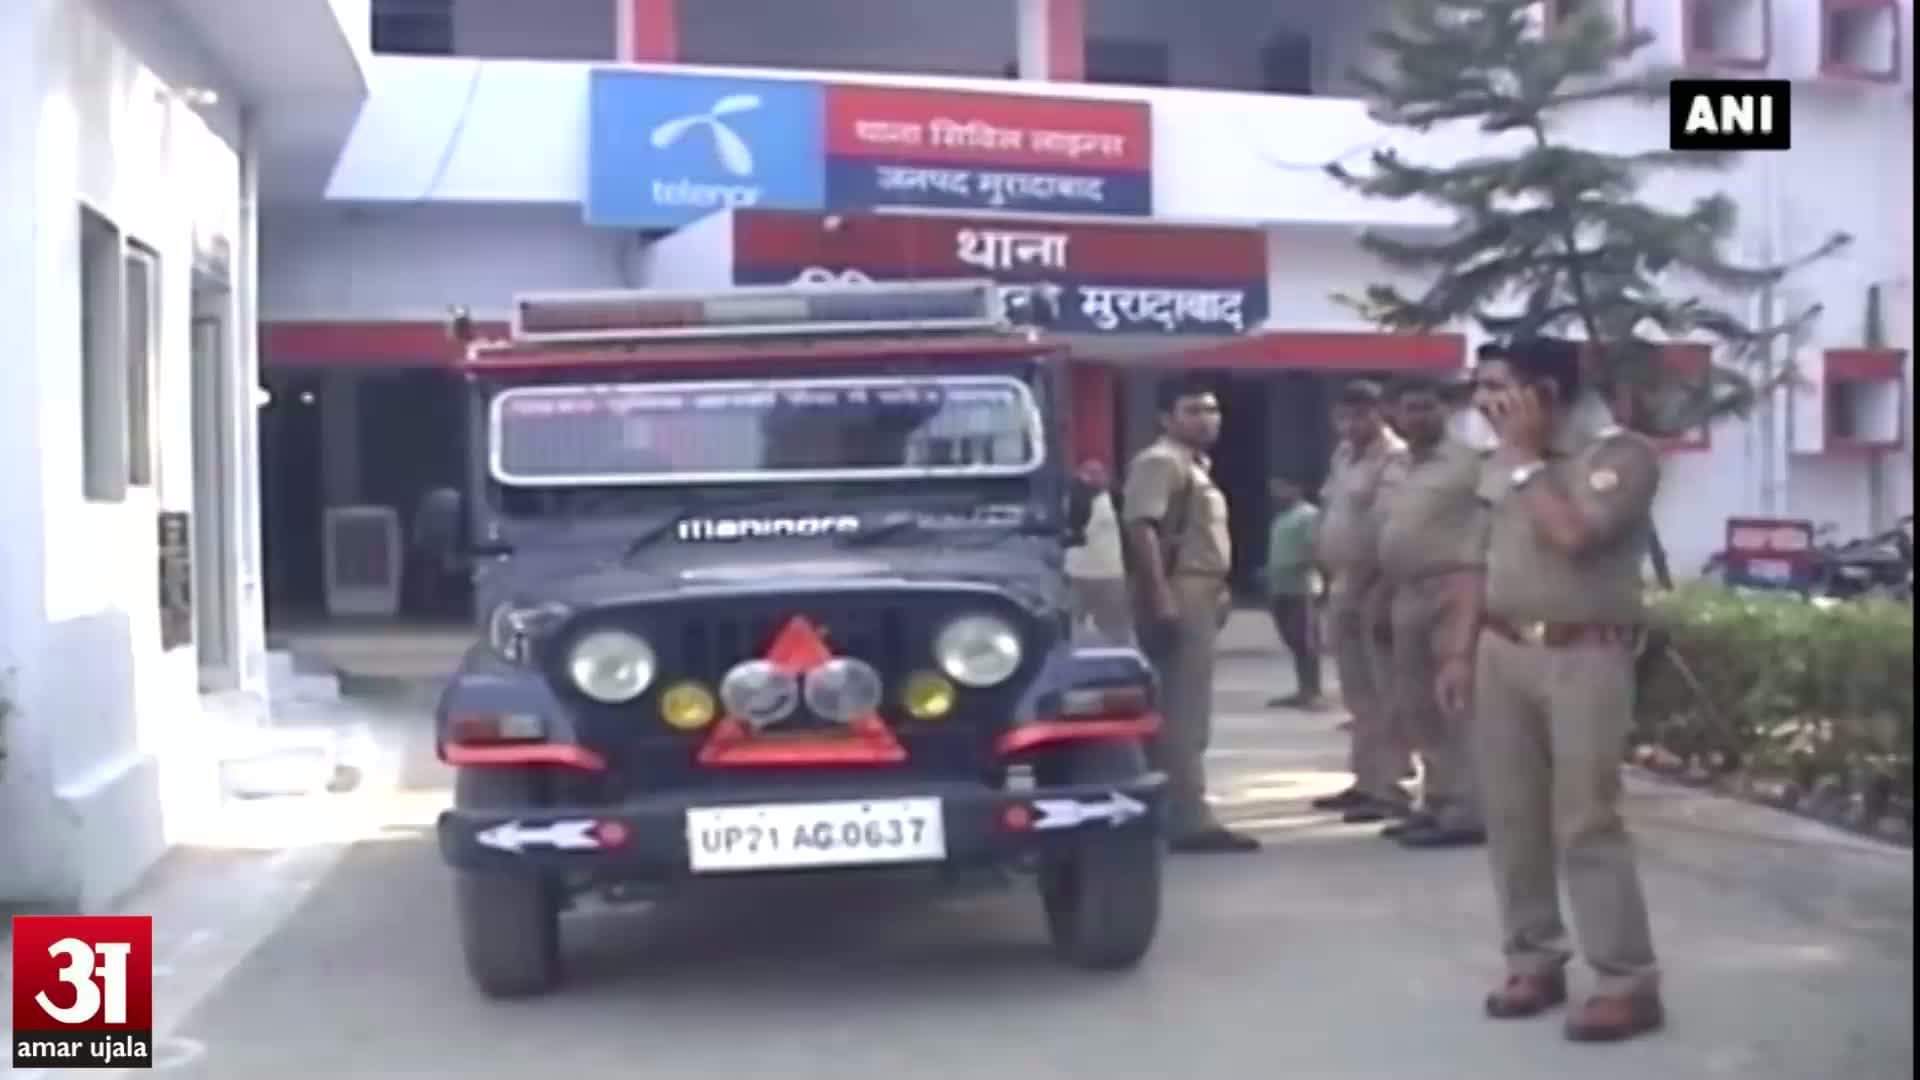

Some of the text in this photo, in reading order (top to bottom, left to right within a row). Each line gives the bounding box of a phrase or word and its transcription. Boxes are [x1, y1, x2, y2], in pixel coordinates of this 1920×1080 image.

[854, 119, 923, 145] थाना
[956, 226, 1068, 270] थाना
[1077, 284, 1245, 331] मुरादाबाद
[700, 826, 781, 855] UP21
